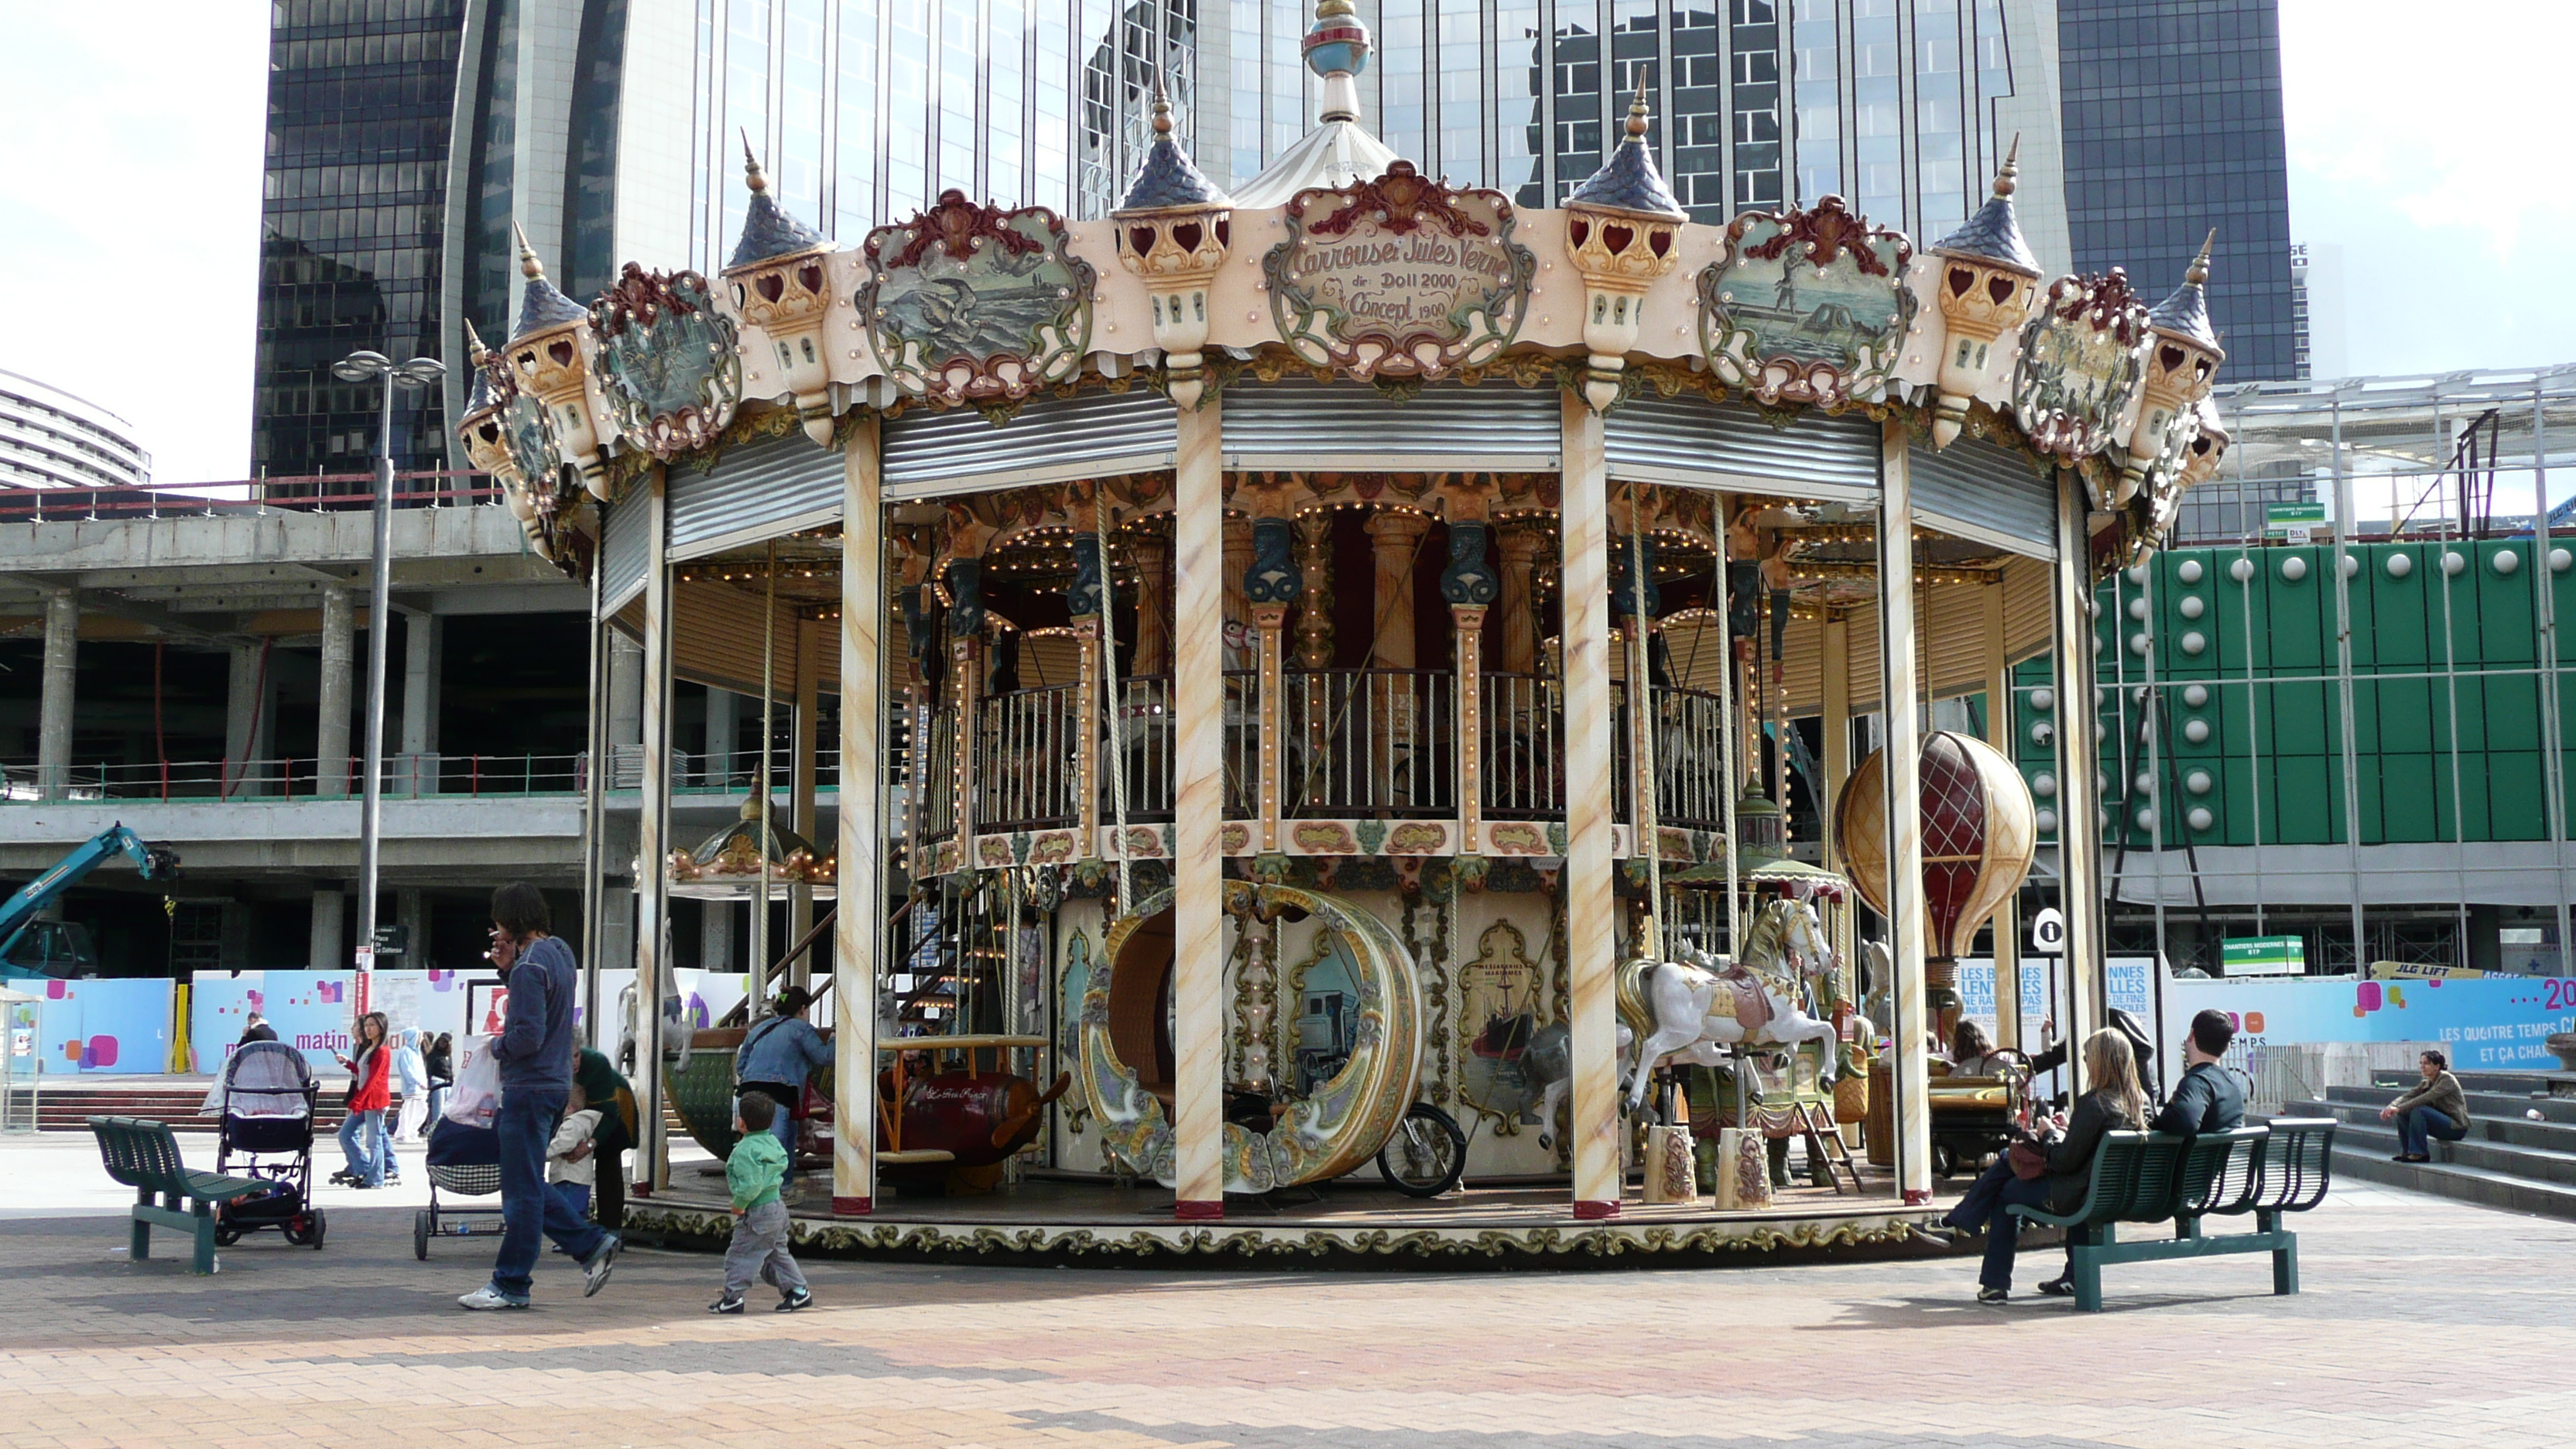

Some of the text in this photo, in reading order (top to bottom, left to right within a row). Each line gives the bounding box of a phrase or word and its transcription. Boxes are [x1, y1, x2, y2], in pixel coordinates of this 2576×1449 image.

[1403, 234, 1458, 265] Jules
[1459, 239, 1509, 276] Verne
[1421, 273, 1457, 288] 2000
[1349, 292, 1446, 325] Concept 1900
[1961, 968, 1983, 980] LES
[2108, 966, 2145, 978] NNES
[2396, 964, 2450, 977] JLG LIFT
[296, 1029, 348, 1050] matin
[2440, 1028, 2460, 1042] LES
[2517, 1023, 2557, 1039] TEMPS
[2230, 1037, 2266, 1048] EMPS
[2481, 1044, 2552, 1064] ET ÇA CHAN
